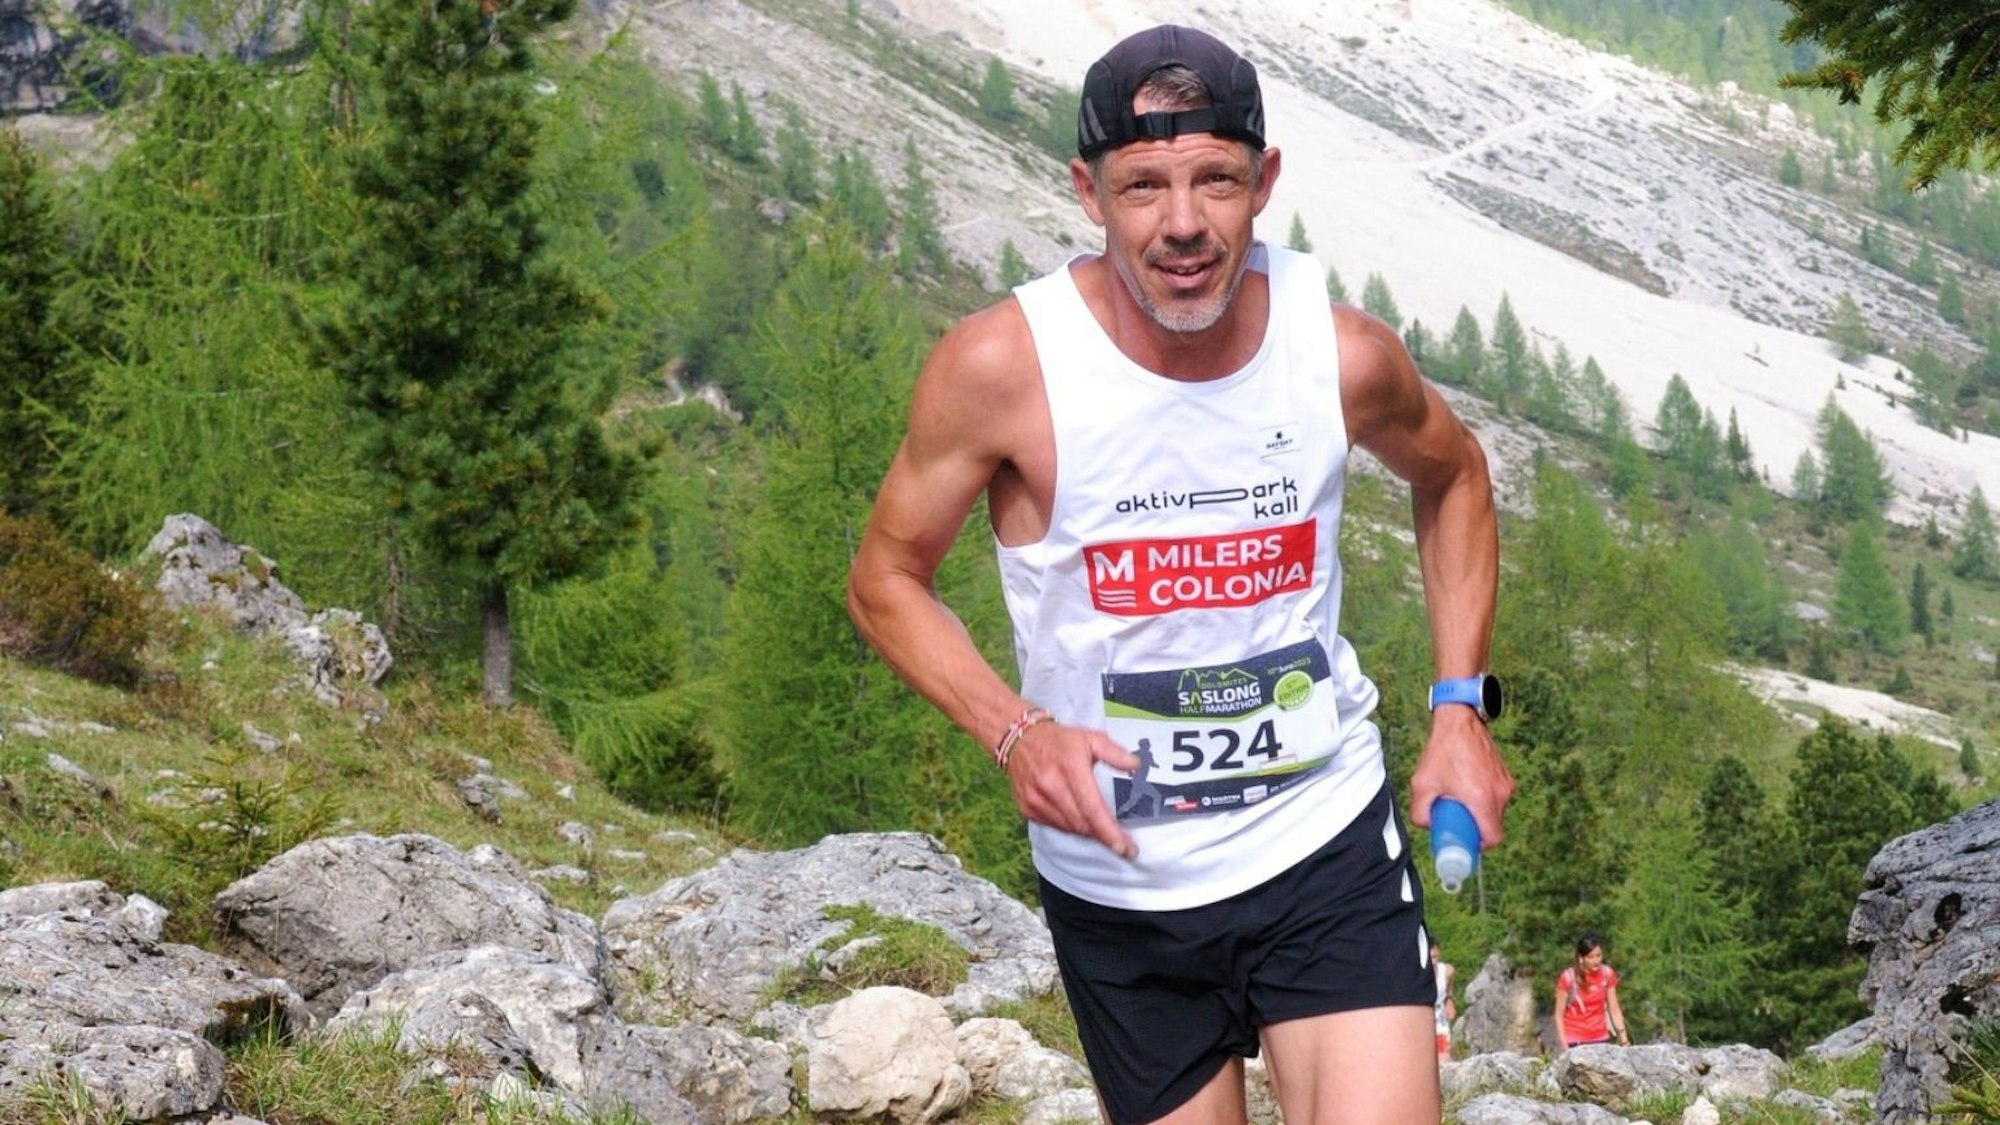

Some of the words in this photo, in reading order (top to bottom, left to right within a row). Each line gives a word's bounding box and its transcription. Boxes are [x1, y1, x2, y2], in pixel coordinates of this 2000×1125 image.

[1254, 495, 1298, 519] kall
[1092, 549, 1135, 586] M
[1147, 534, 1283, 572] MILERS
[1149, 561, 1307, 607] COLONIA
[1178, 681, 1261, 706] SASLONG
[1180, 696, 1262, 714] HALFMARATHON
[1172, 719, 1282, 772] 524
